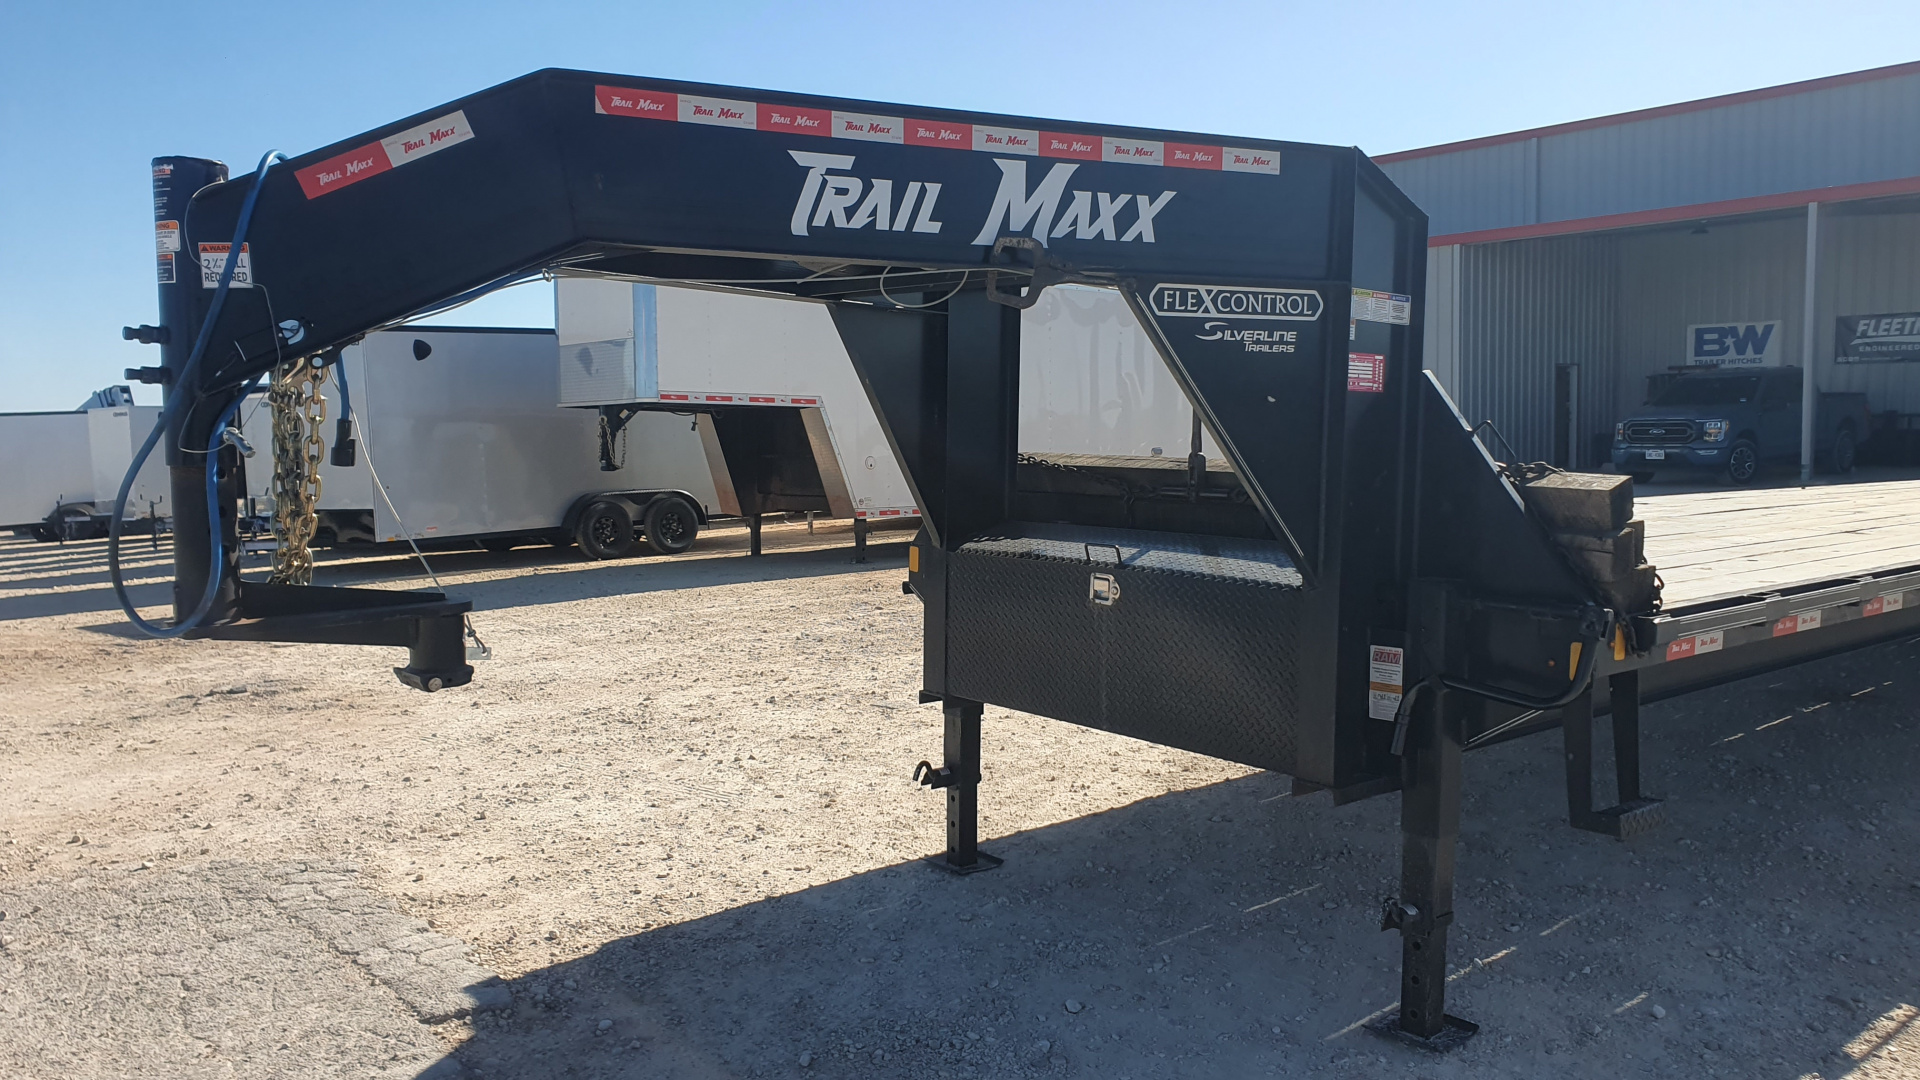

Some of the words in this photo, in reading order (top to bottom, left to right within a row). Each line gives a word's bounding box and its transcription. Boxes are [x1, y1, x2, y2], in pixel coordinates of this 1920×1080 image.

[611, 96, 632, 108] TRAIL
[636, 98, 665, 112] MAXX
[693, 105, 713, 116] TRAIL
[717, 107, 744, 119] MAXX
[771, 113, 790, 125] TRAIL
[794, 115, 820, 127] MAXX
[845, 121, 863, 132] TRAIL
[867, 122, 892, 134] MAXX
[917, 128, 935, 139] TRAIL
[938, 129, 962, 141] MAXX
[401, 138, 425, 154] TRAIL
[429, 126, 456, 145] MAXX
[985, 134, 1003, 144] TRAIL
[1006, 135, 1028, 147] MAXX
[316, 170, 342, 186] TRAIL
[345, 157, 373, 177] MAXX
[787, 149, 943, 237] TRAIL
[971, 158, 1177, 249] MAXX
[204, 271, 248, 283] REQRED
[1163, 287, 1313, 317] FLEXCONTROL
[1195, 321, 1297, 342] SILVERLINE
[1243, 341, 1295, 353] TRAILERS
[1728, 357, 1763, 365] HITCHES
